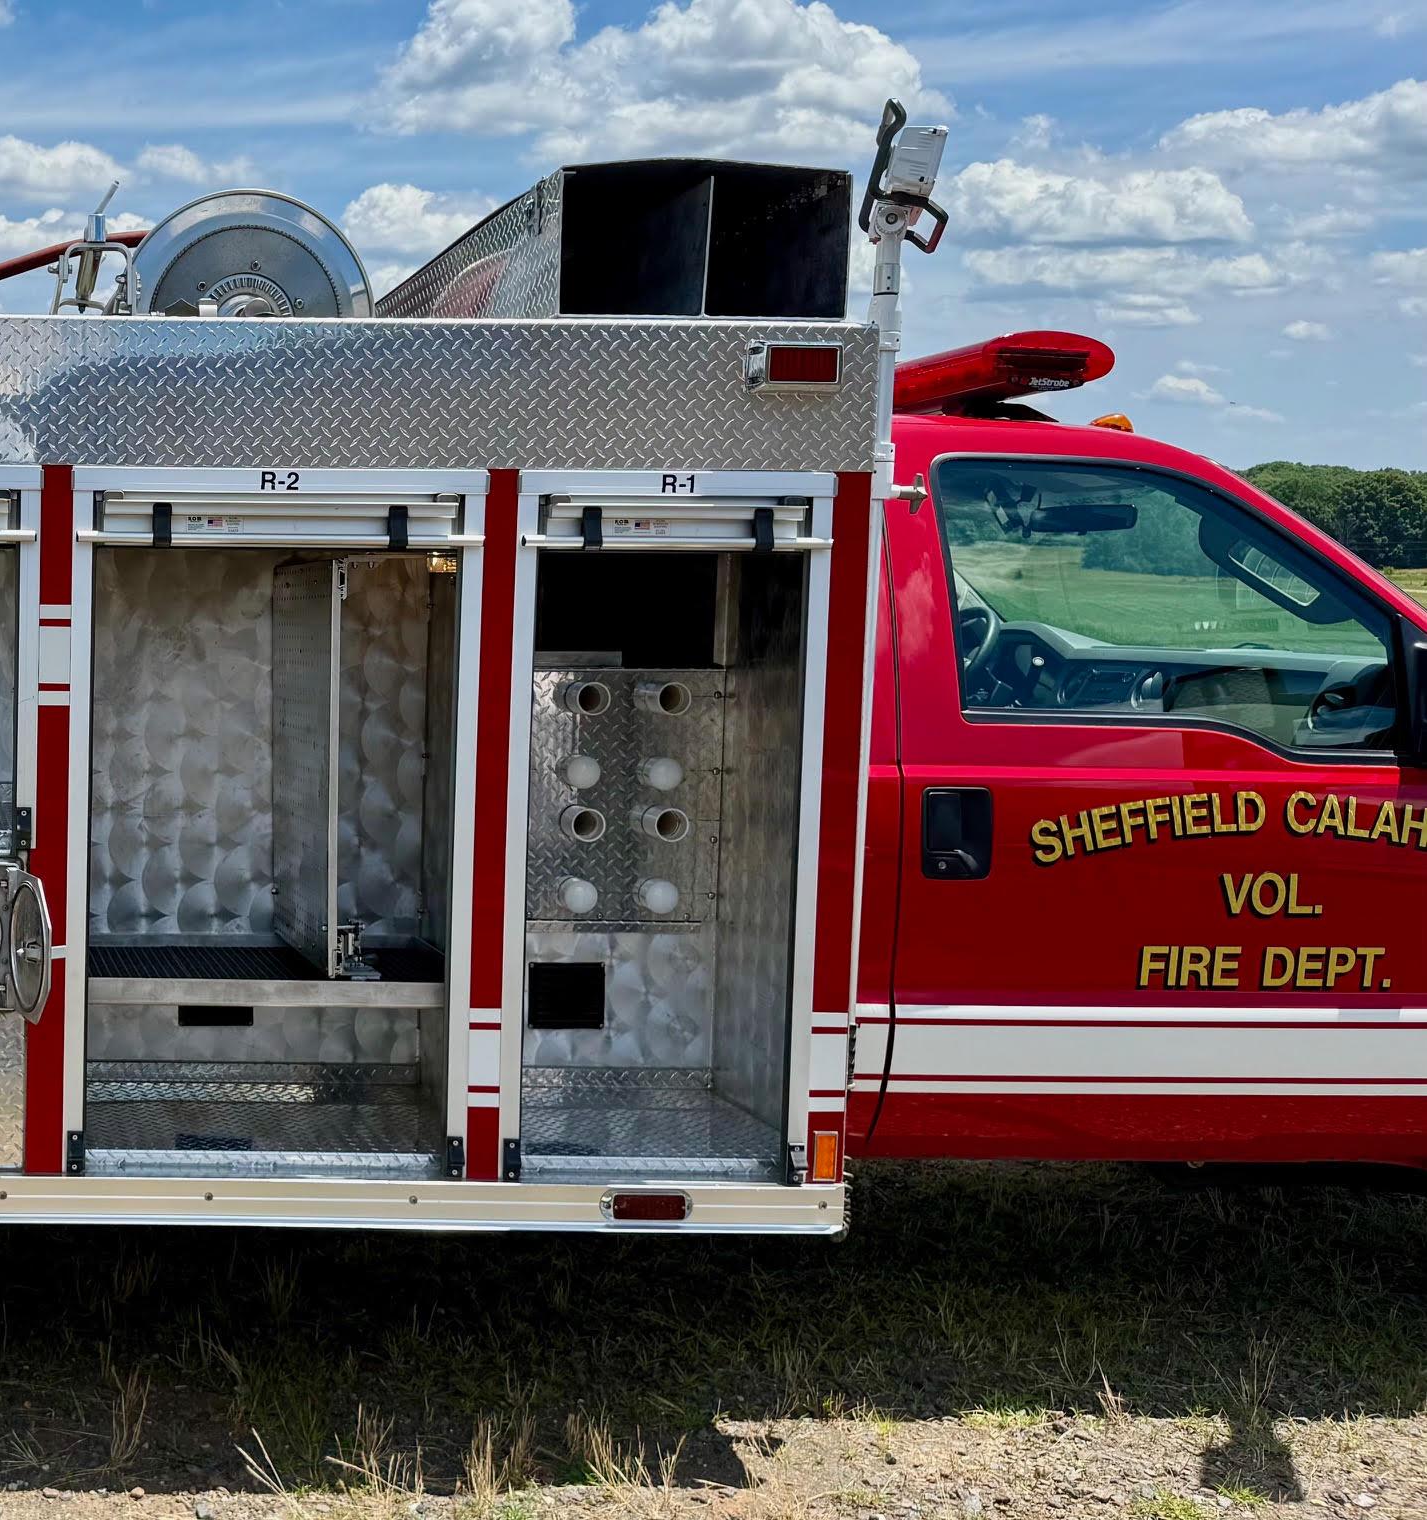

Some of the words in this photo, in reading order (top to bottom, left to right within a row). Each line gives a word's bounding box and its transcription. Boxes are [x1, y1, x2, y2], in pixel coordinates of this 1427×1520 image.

[1028, 377, 1070, 388] JetStrobe
[260, 471, 300, 491] R-2
[661, 474, 695, 493] R-1
[1029, 791, 1267, 864] SHEFFIELD
[1285, 790, 1427, 849] CALAH
[1221, 871, 1324, 916] VOL.
[1138, 945, 1243, 987] FIRE
[1261, 946, 1393, 988] DEPT.
